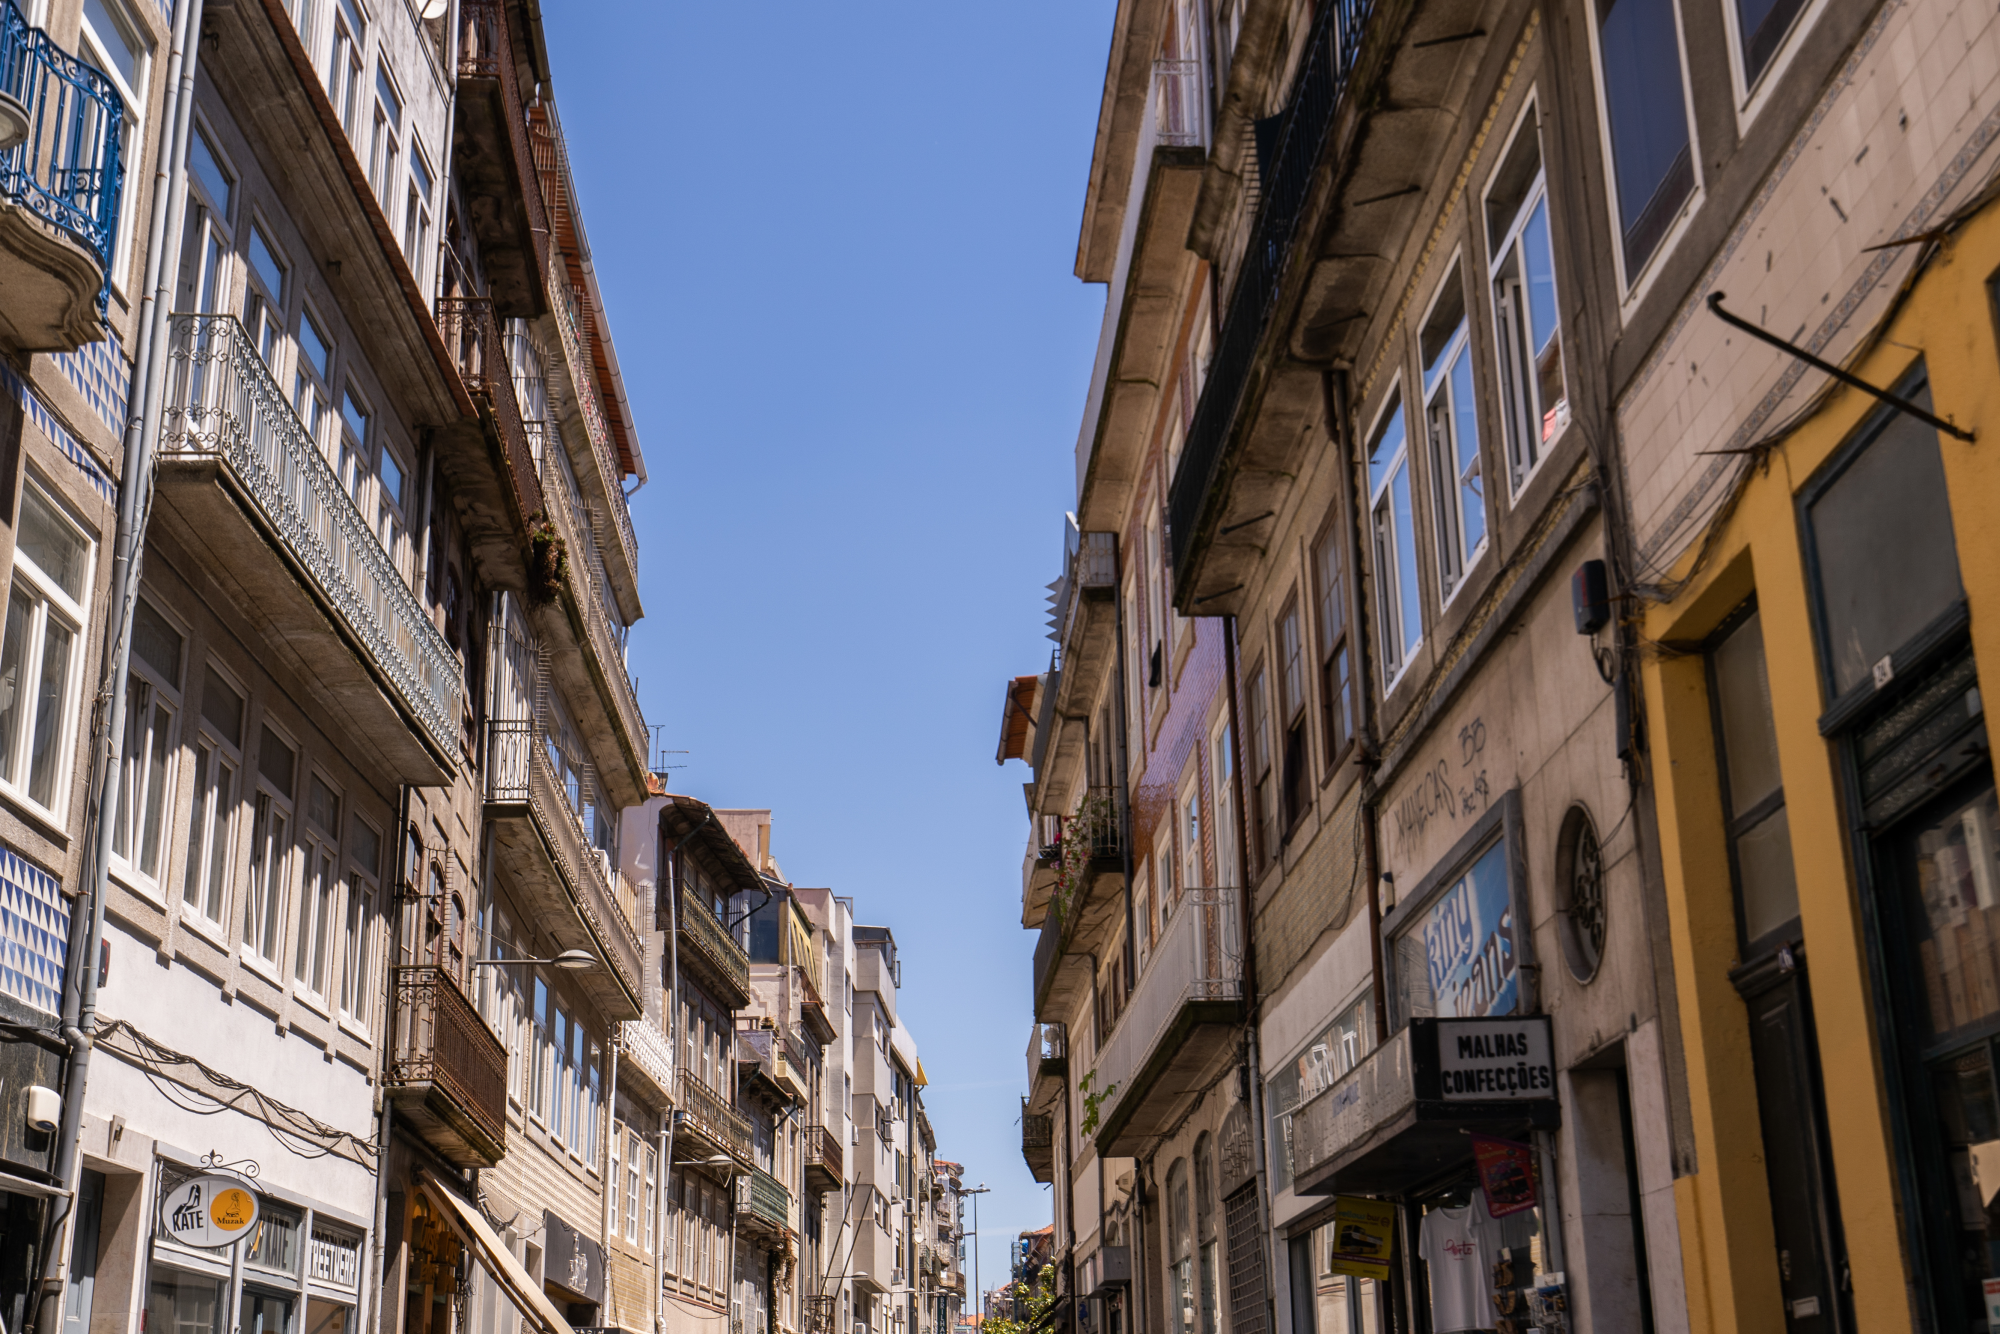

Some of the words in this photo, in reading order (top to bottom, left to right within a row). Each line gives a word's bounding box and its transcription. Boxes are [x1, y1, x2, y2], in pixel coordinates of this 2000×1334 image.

[1457, 1033, 1528, 1059] MALHAS
[1442, 1062, 1550, 1096] CONFECÇÕES
[172, 1210, 204, 1232] KATE
[216, 1216, 245, 1225] Muzak
[264, 1214, 290, 1270] KATE
